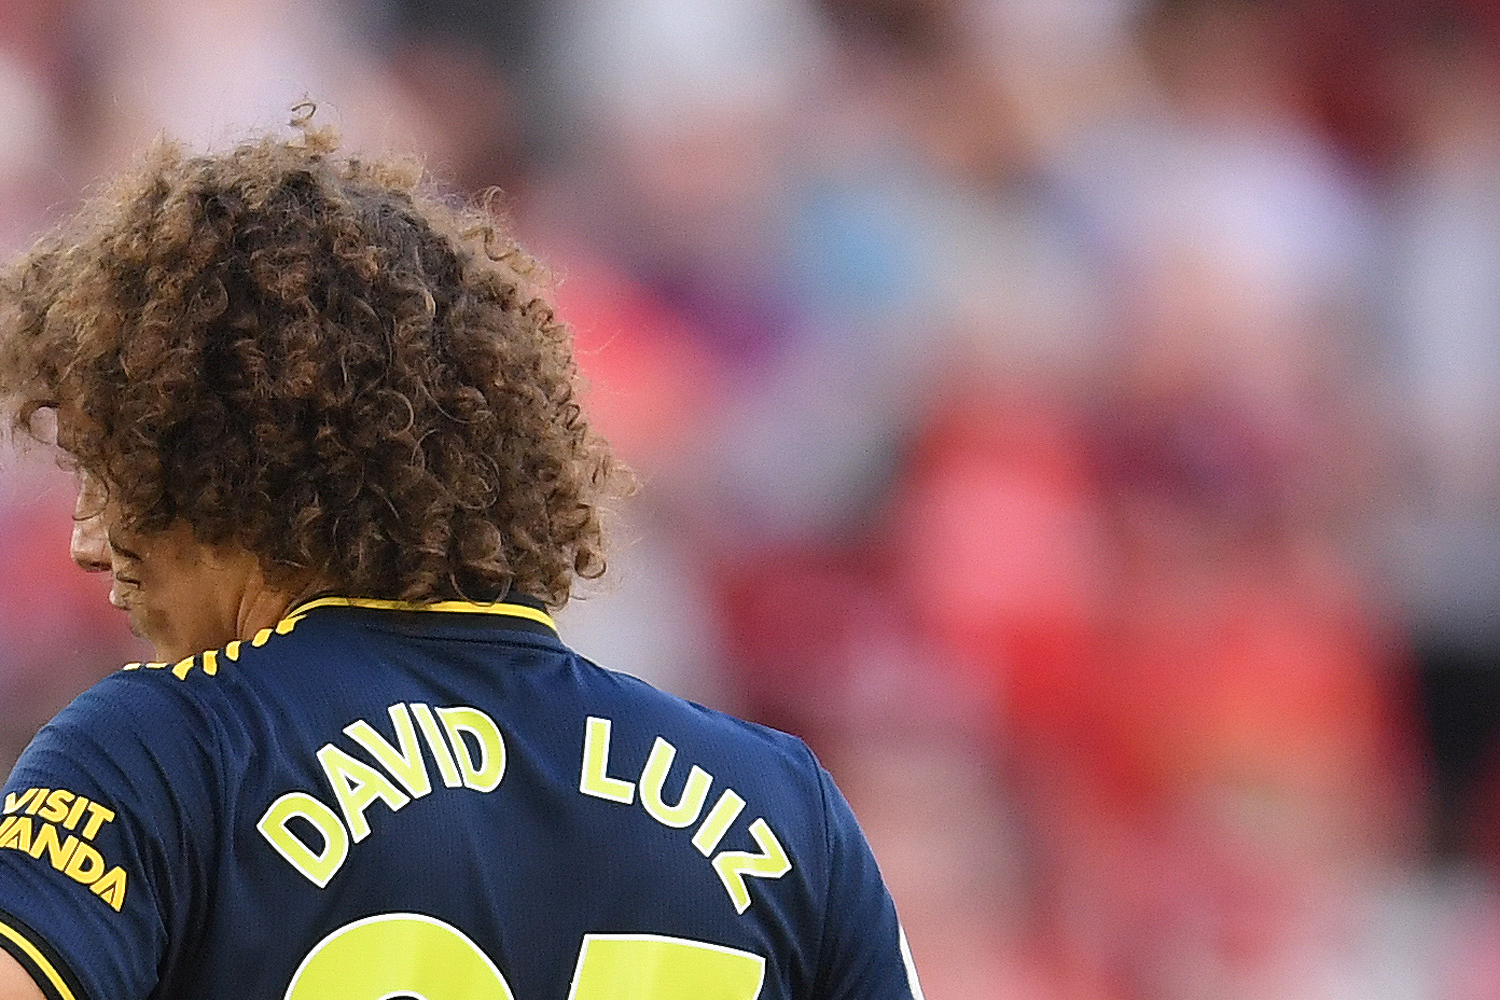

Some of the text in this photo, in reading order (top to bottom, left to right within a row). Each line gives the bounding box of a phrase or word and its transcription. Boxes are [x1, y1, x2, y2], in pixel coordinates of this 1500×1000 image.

[2, 787, 116, 841] VISIT
[256, 702, 792, 915] DAVID LUIZ
